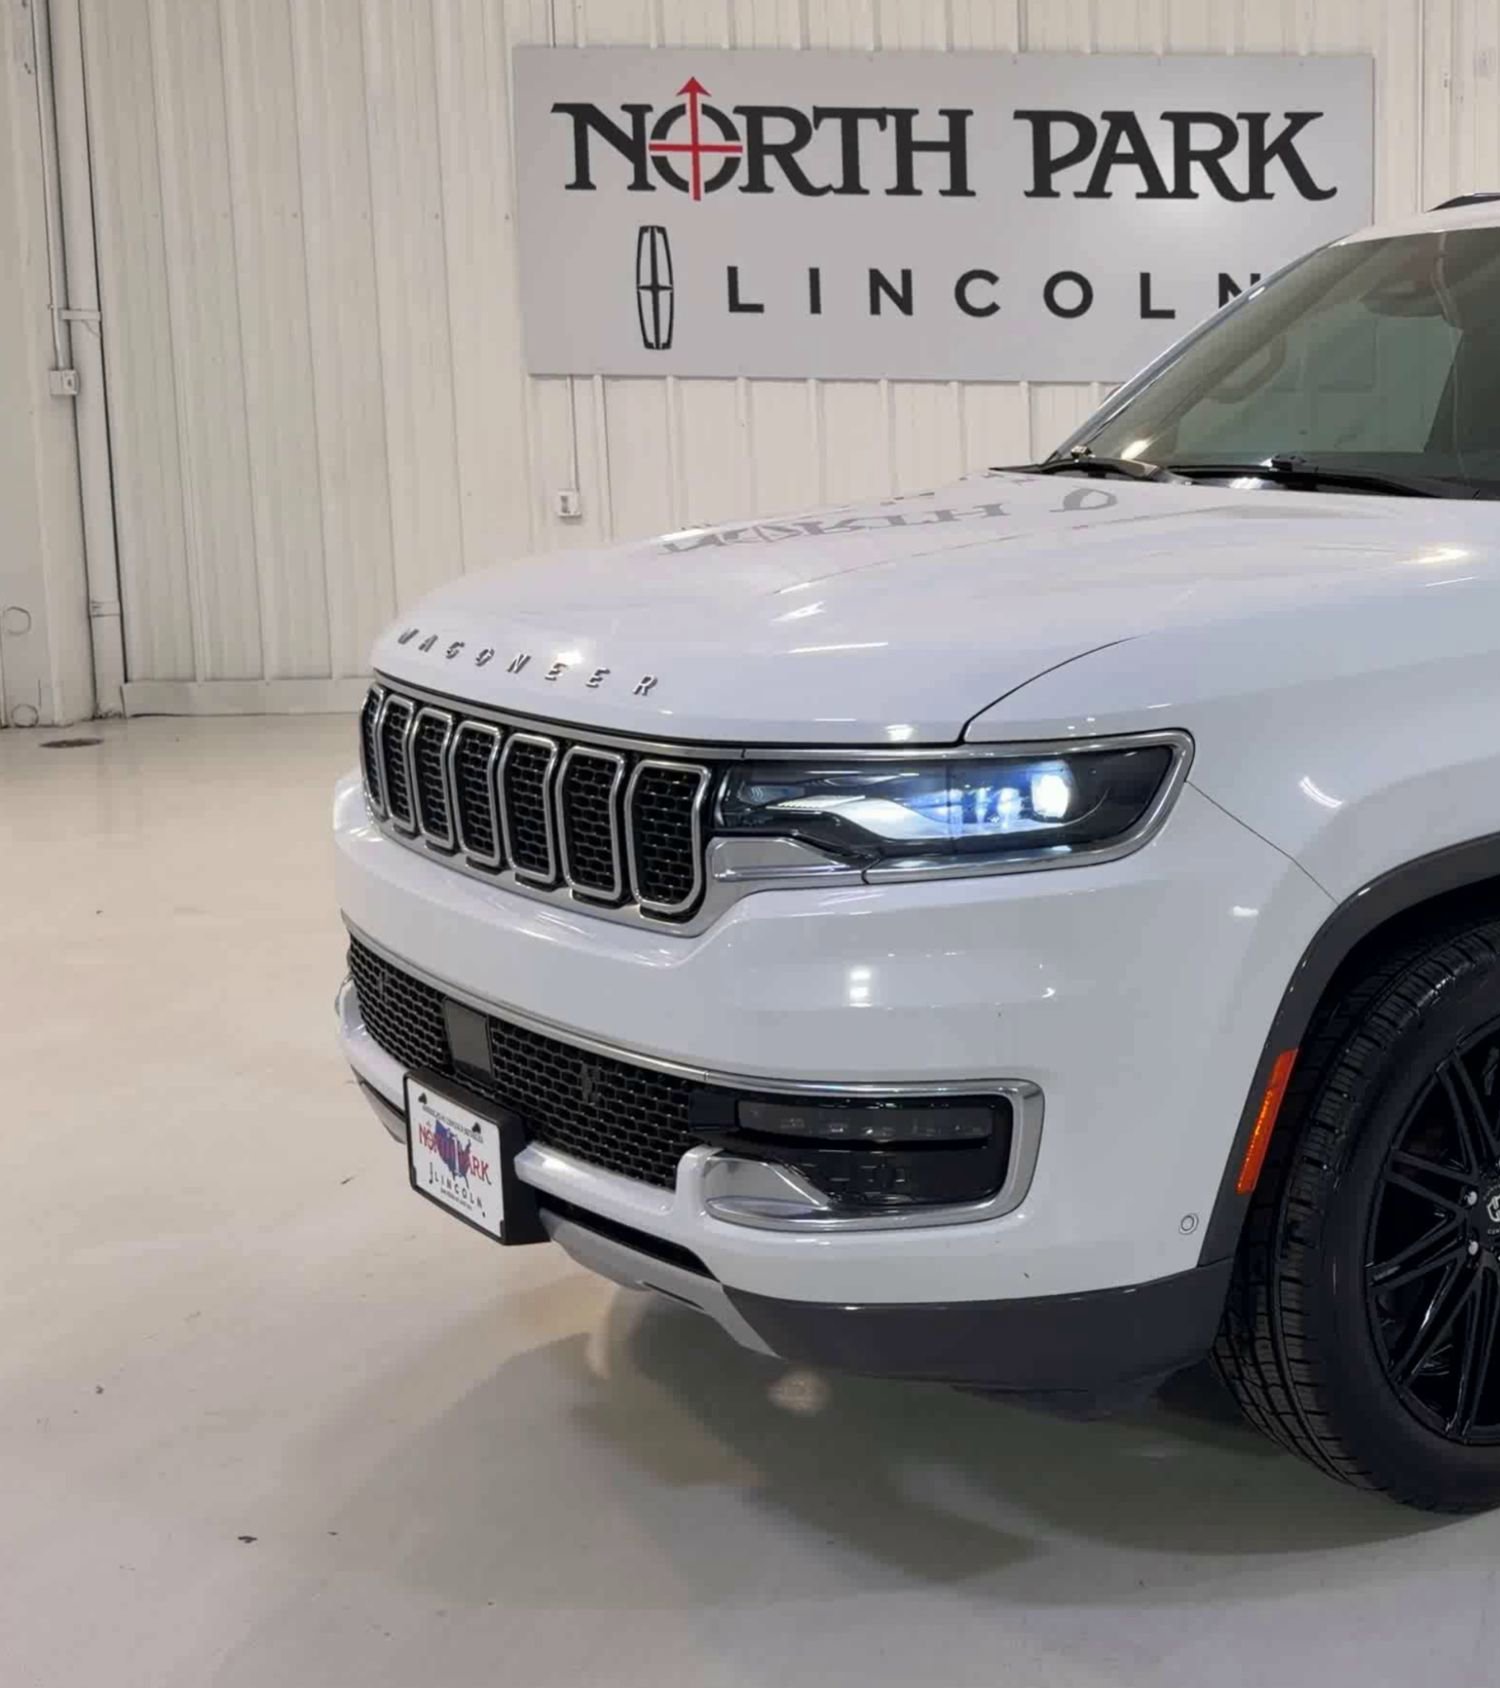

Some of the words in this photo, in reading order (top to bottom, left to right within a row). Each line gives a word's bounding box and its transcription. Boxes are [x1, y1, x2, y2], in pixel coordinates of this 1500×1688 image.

[551, 102, 977, 197] NORTH
[1013, 110, 1338, 202] PARK
[397, 627, 658, 697] WAGONEER
[434, 1173, 484, 1210] LINCOLN
